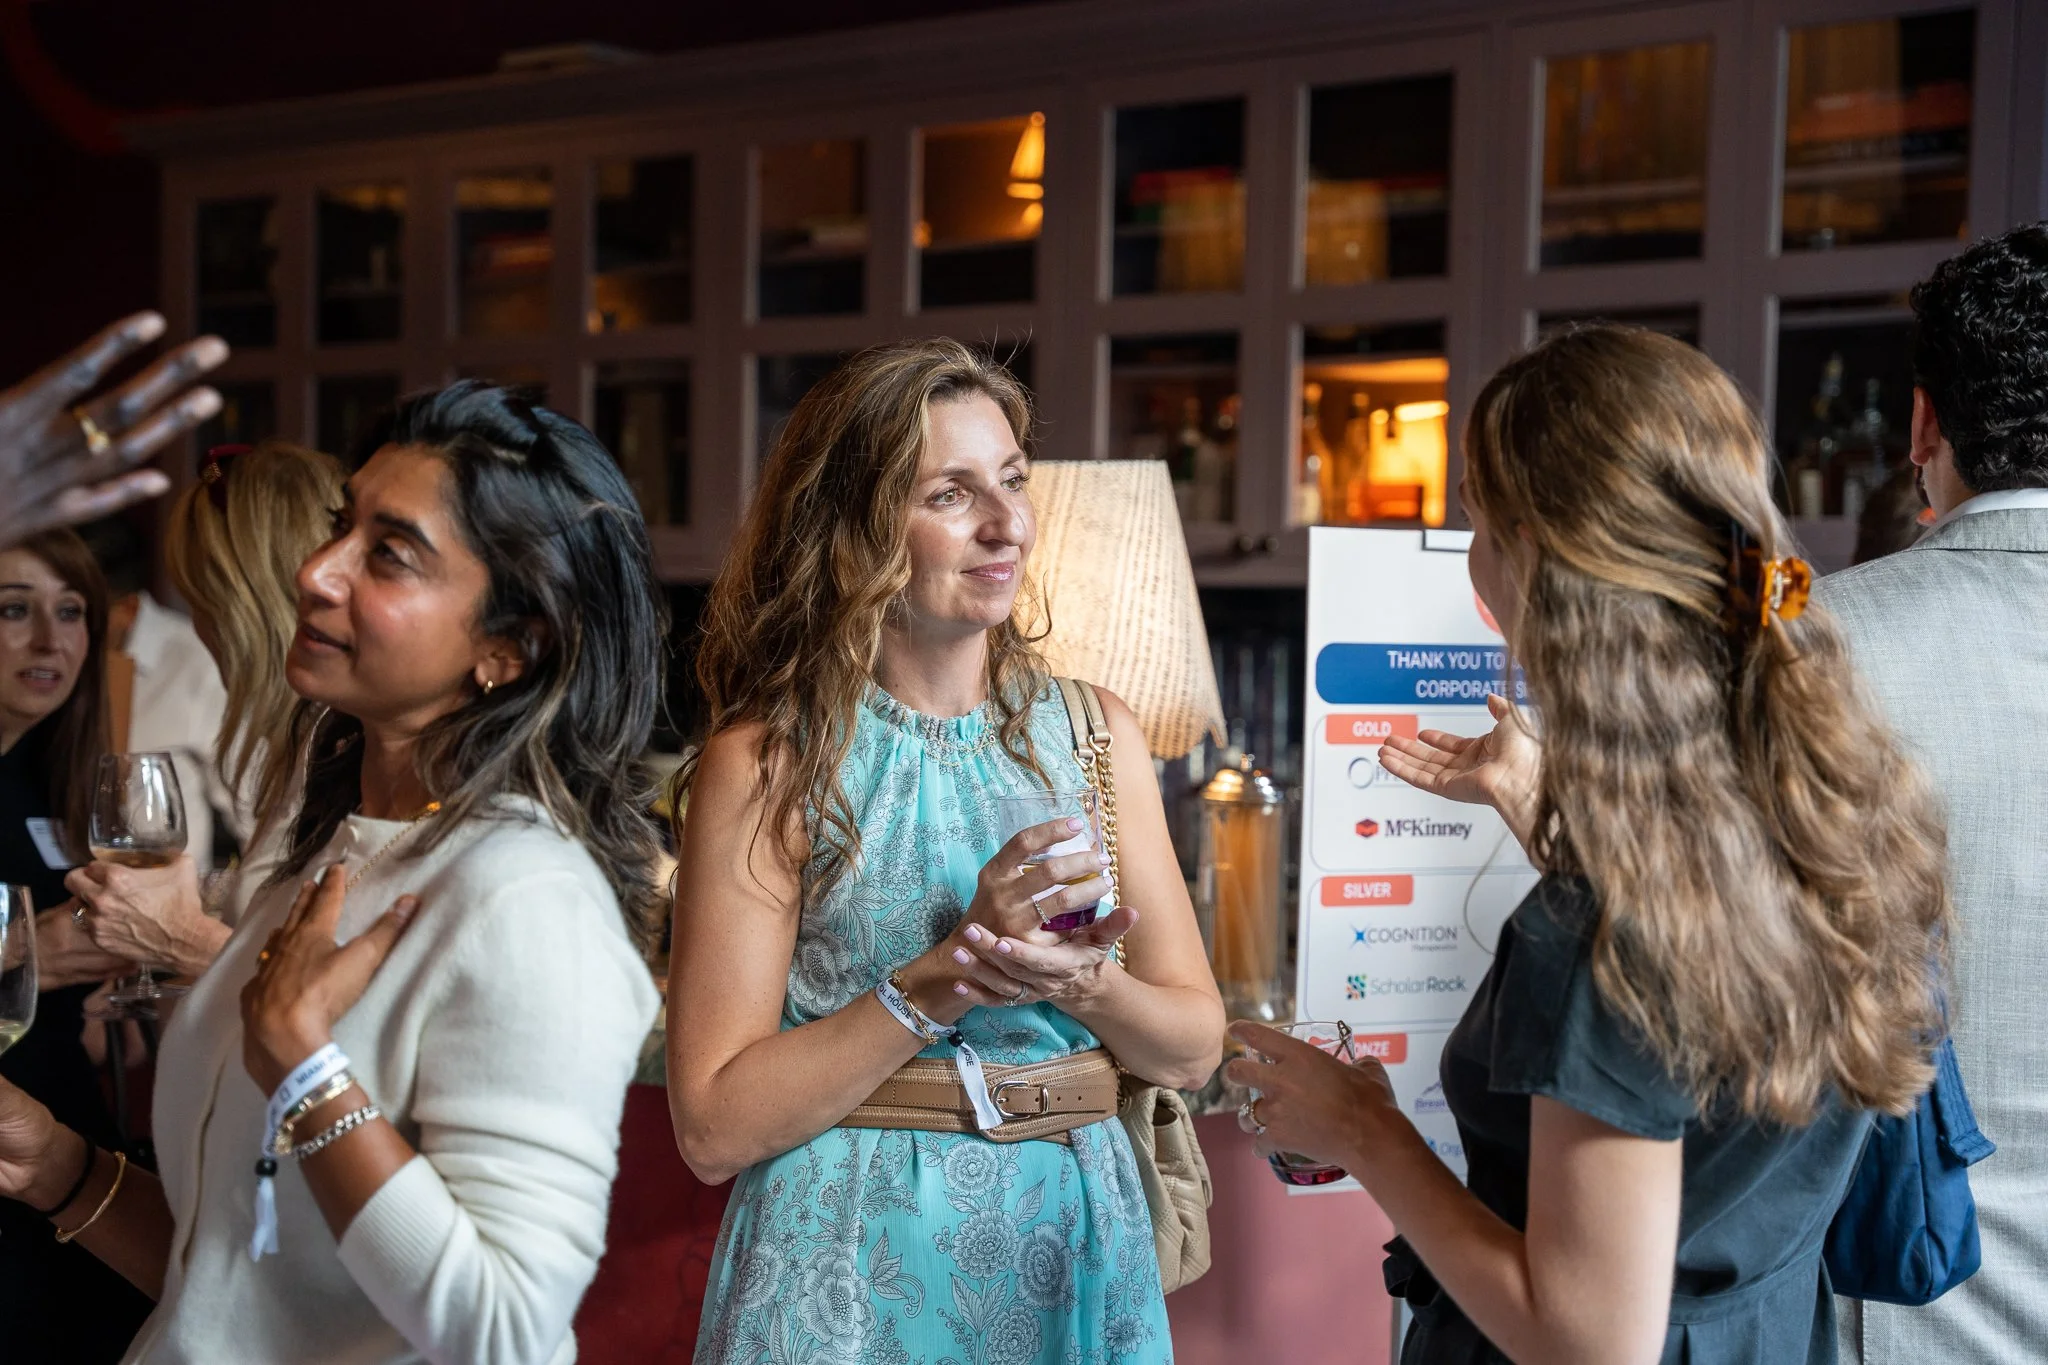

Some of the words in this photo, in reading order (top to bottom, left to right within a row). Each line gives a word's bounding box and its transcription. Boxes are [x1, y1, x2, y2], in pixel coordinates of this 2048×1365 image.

[1386, 650, 1445, 670] THANK
[1447, 651, 1481, 670] YOU
[1483, 651, 1506, 670] TO
[1352, 720, 1392, 737] GOLD
[1385, 817, 1473, 840] McKinney
[1343, 881, 1392, 899] SILVER
[1367, 925, 1458, 943] COGNITION
[887, 993, 913, 1020] HOUSE
[1352, 1041, 1390, 1058] ONZE
